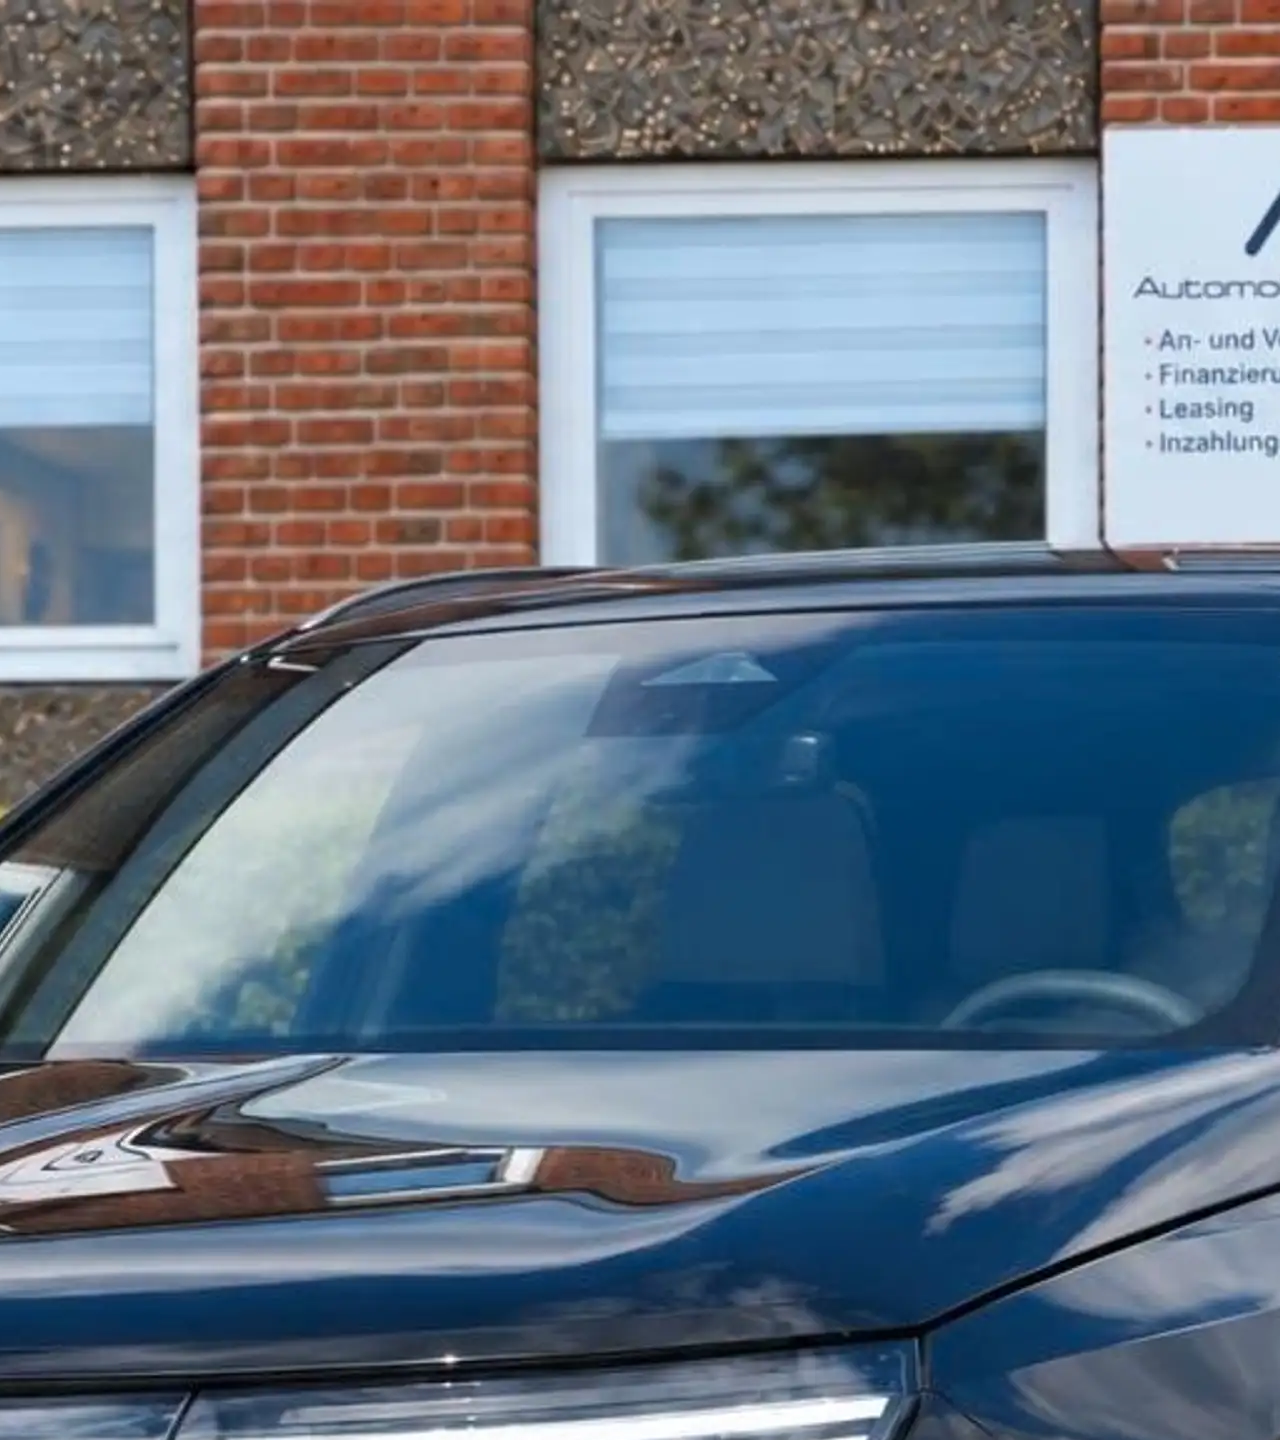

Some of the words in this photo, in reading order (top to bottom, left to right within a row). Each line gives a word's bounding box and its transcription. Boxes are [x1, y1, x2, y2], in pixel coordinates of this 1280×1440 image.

[1158, 329, 1201, 350] An-
[1209, 328, 1255, 350] und
[1158, 399, 1255, 422] Leasing
